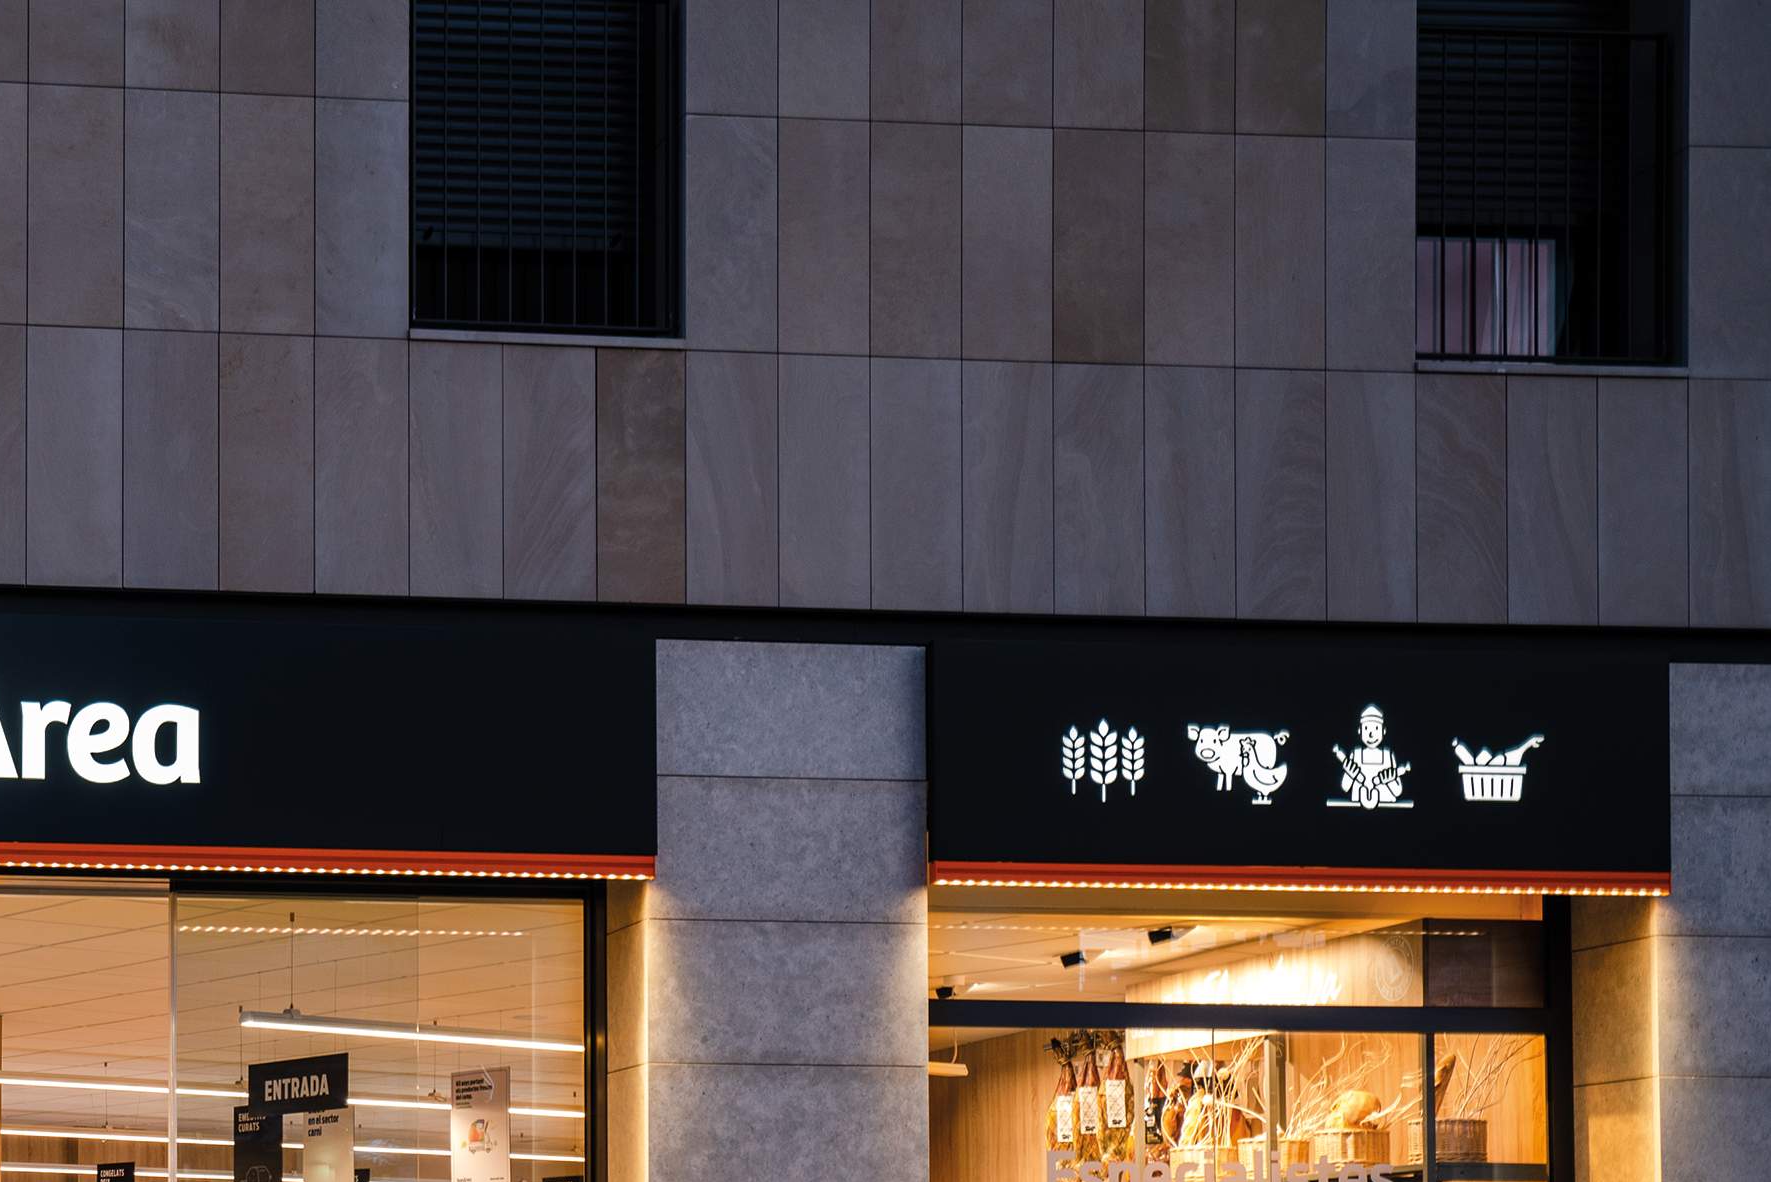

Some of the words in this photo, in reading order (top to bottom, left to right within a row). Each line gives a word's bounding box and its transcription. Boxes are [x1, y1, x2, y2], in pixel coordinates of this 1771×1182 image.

[264, 1074, 330, 1102] ENTRADA
[322, 1114, 339, 1125] sector
[238, 1122, 260, 1133] CURATS
[100, 1168, 125, 1178] CONGELATS
